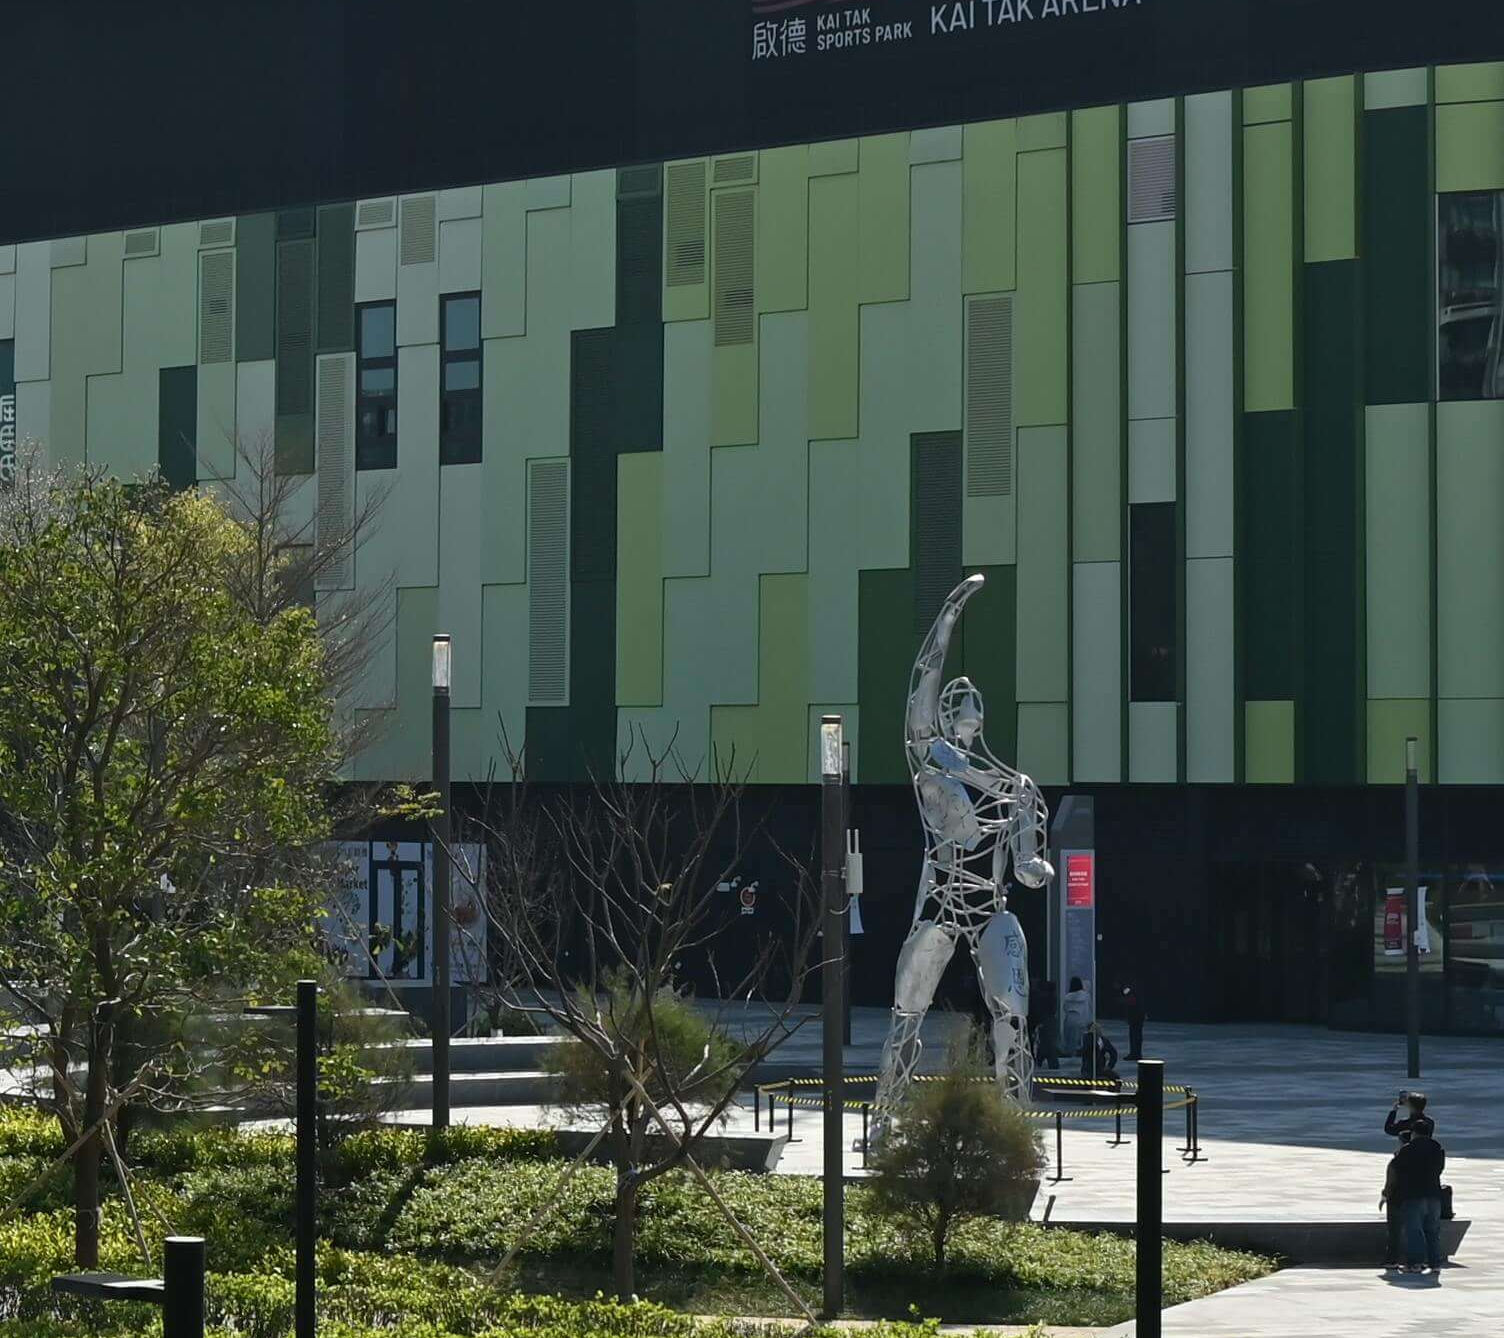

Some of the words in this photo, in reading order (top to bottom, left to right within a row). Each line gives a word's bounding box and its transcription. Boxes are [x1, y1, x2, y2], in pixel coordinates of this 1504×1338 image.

[817, 12, 840, 31] KAI
[844, 7, 871, 27] TAK
[930, 0, 975, 35] KAI
[752, 17, 807, 60] 啟德
[817, 27, 871, 51] SPORTS
[875, 21, 913, 42] PARK
